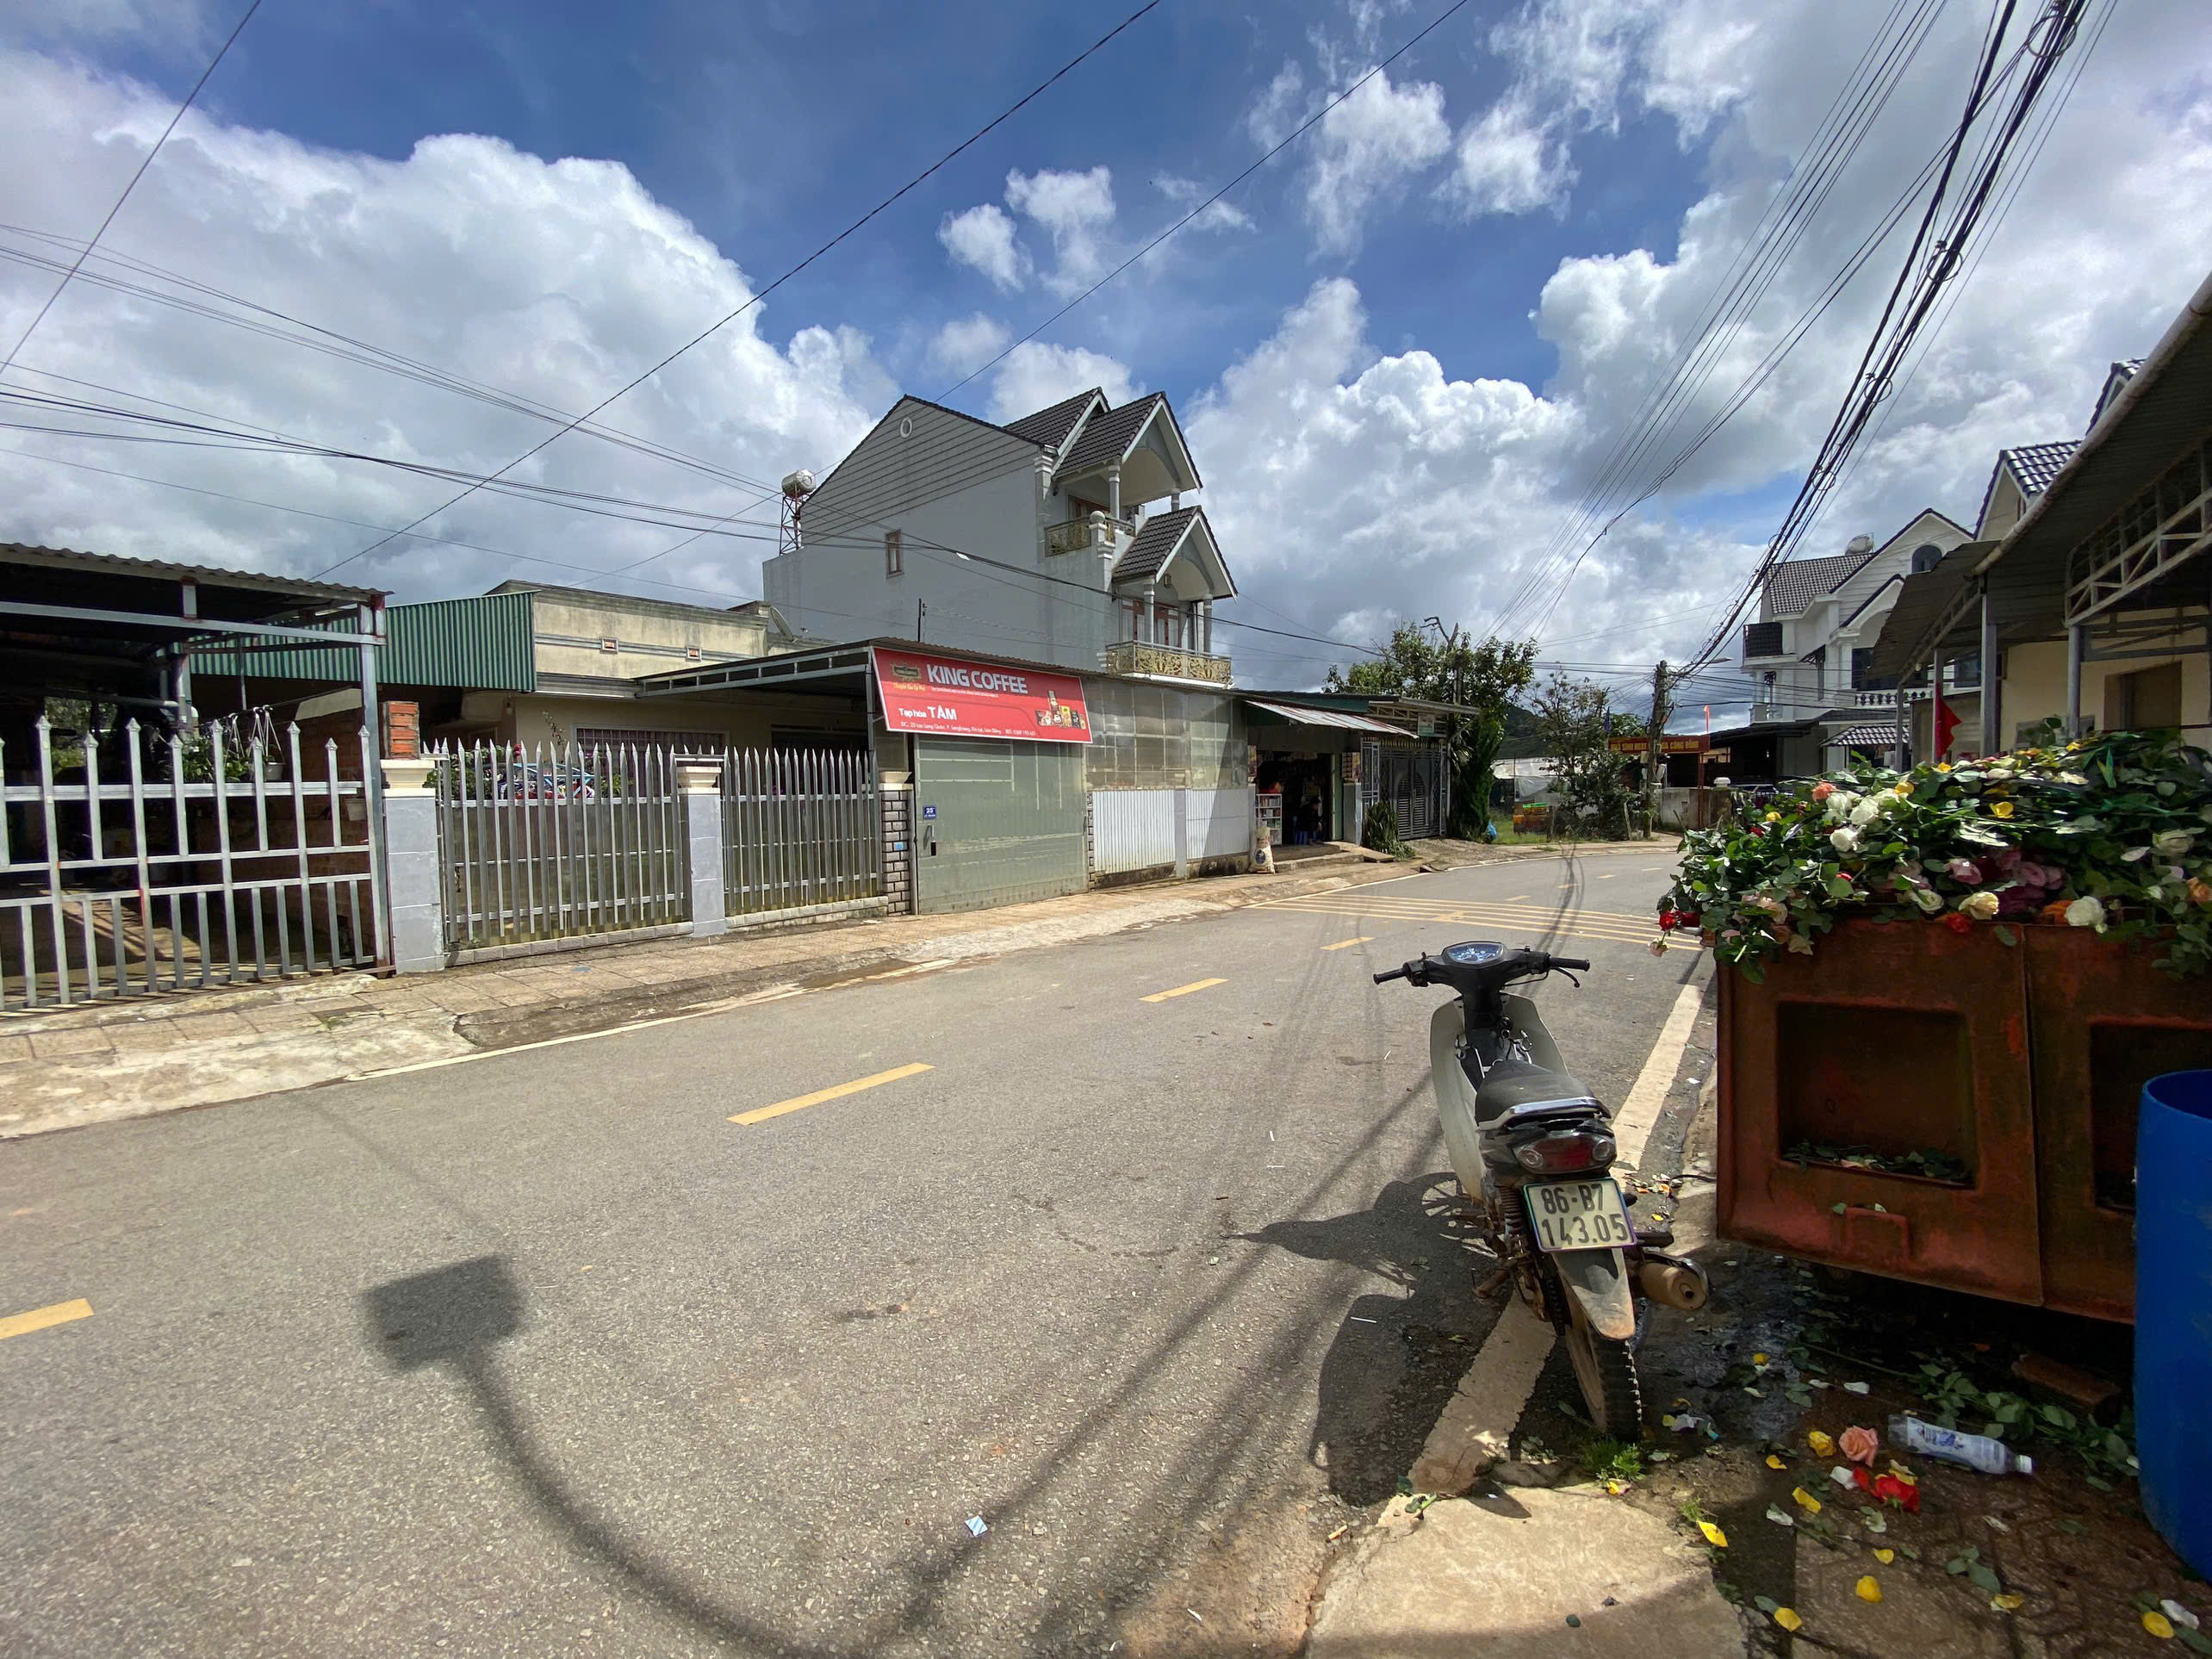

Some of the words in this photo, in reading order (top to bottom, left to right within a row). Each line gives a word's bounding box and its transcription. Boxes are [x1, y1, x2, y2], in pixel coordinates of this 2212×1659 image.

[927, 664, 970, 687] KING
[971, 671, 1028, 694] COFFEE
[927, 705, 958, 721] TÂM
[1542, 1214, 1628, 1246] 143.05
